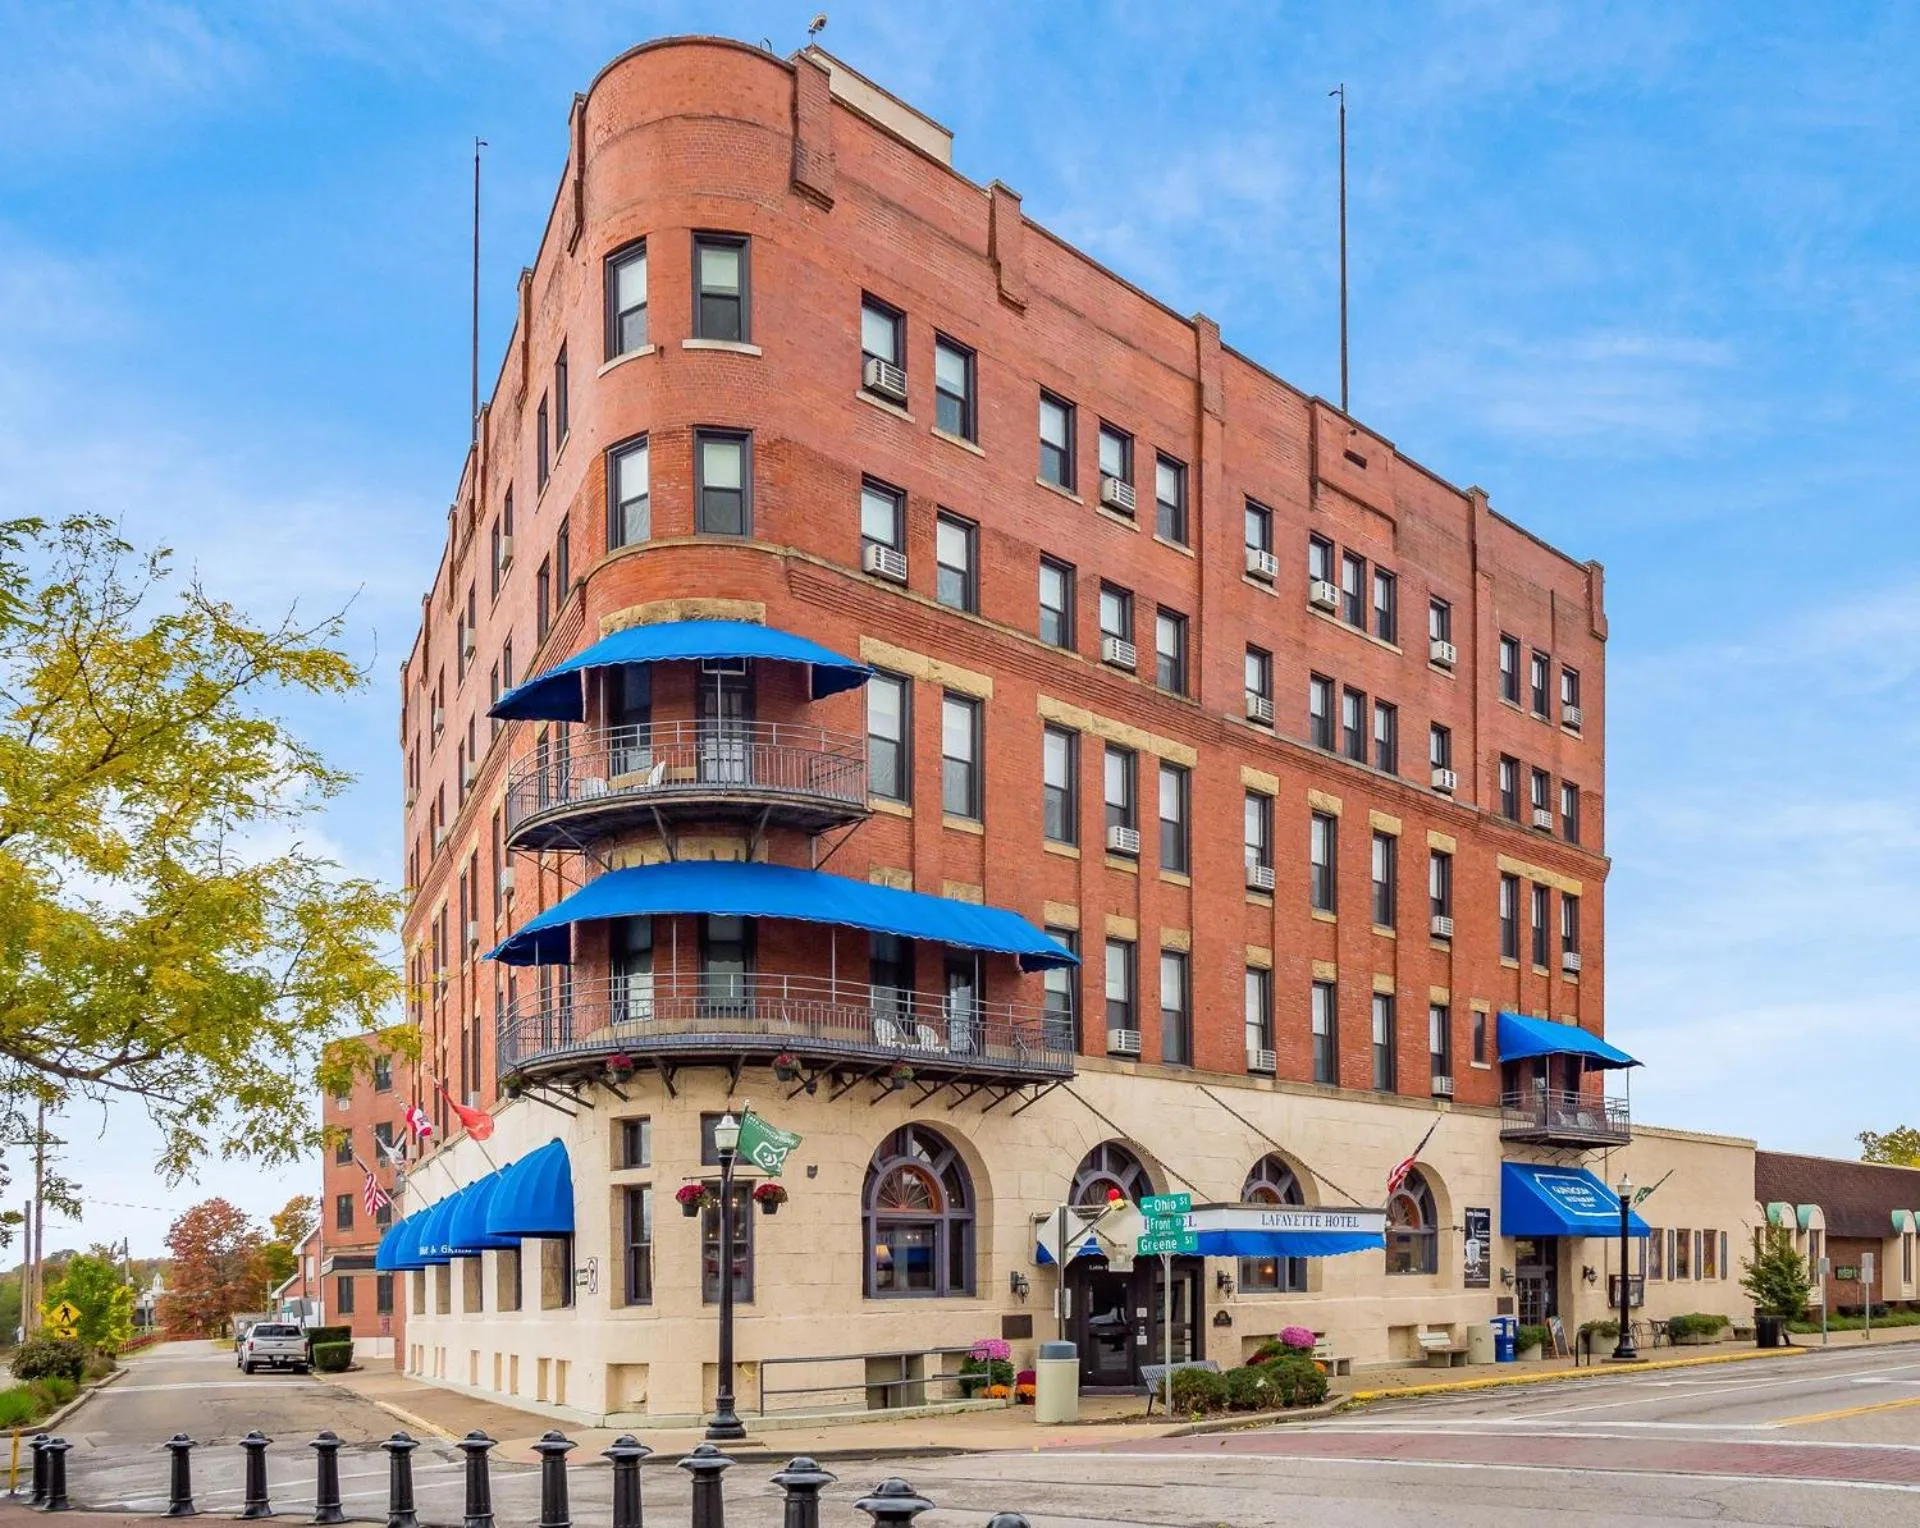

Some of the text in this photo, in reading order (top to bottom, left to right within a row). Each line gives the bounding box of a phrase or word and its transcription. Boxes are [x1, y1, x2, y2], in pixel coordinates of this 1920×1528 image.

[1153, 1198, 1177, 1212] Ohio
[1150, 1217, 1171, 1231] Front
[1261, 1213, 1360, 1229] LAFAYETTE HOTEL
[1141, 1238, 1178, 1252] Greene
